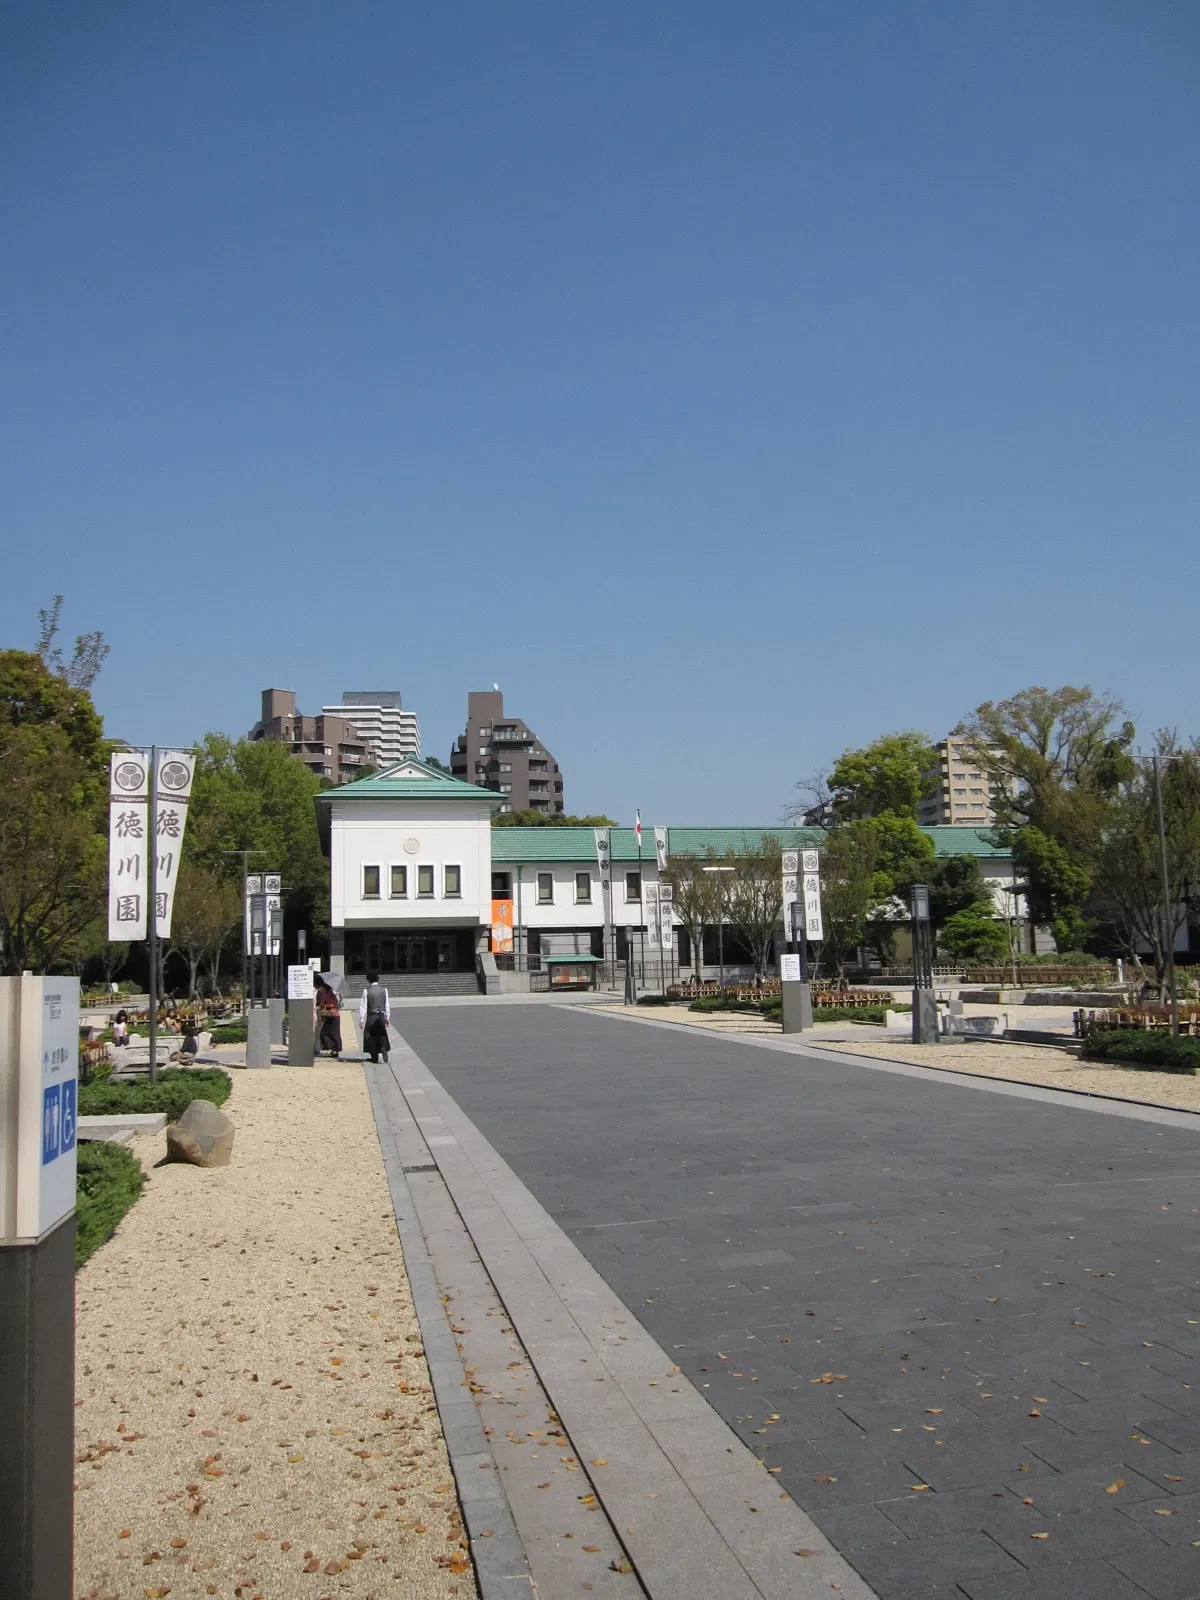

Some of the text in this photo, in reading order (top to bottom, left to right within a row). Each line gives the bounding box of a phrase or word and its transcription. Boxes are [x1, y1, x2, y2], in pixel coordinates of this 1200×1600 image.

[115, 811, 144, 922] 徳川園
[806, 879, 819, 932] 徳川園
